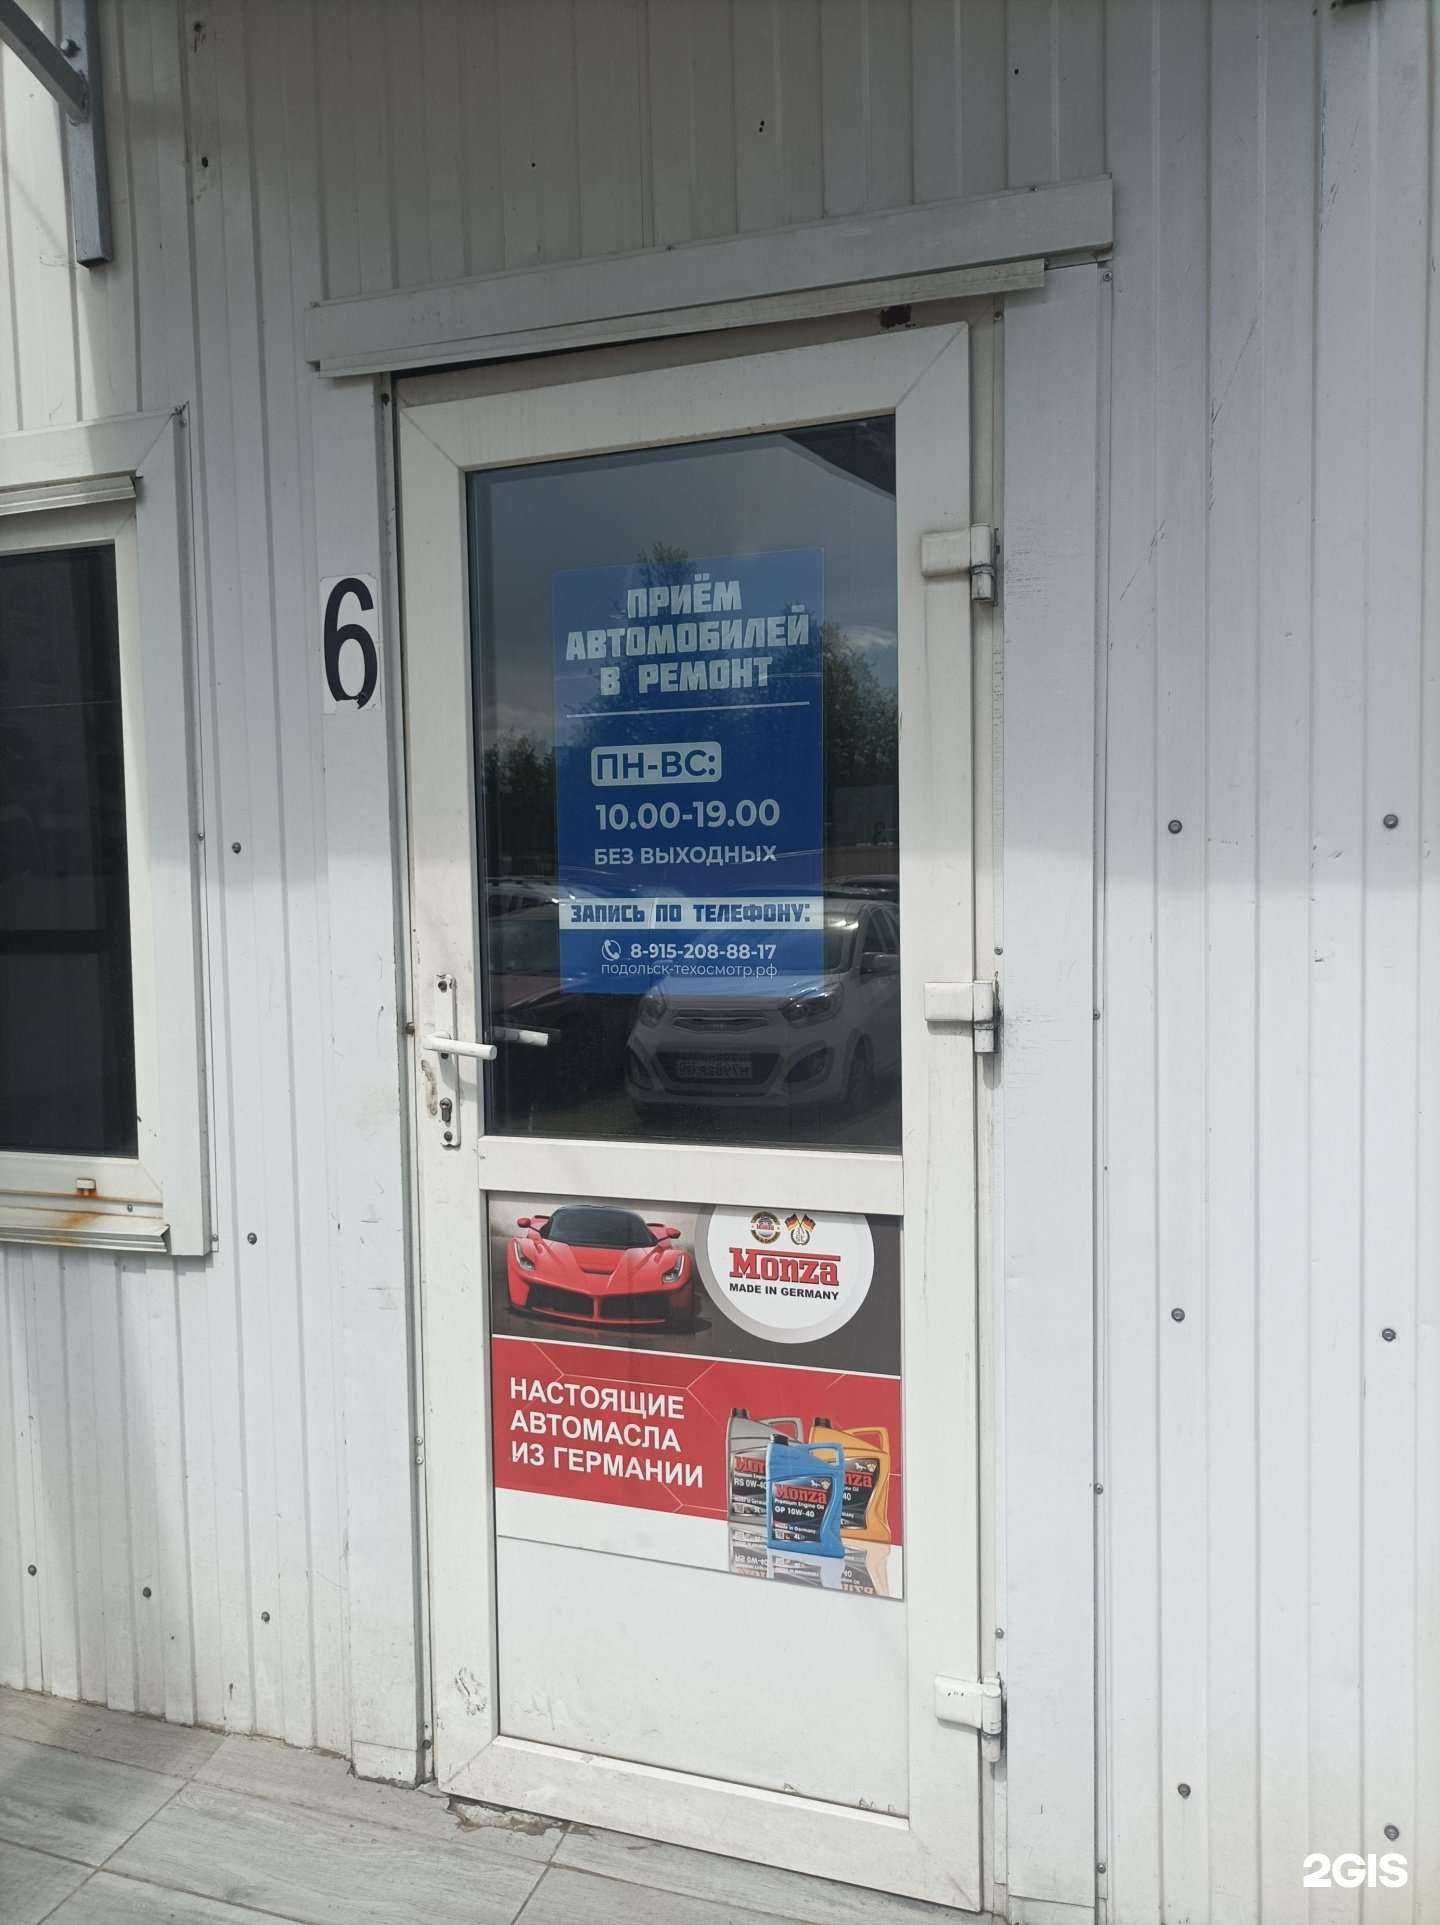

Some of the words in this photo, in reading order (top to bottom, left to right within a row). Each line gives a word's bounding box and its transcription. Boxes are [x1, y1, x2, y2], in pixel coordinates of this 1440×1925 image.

[627, 573, 742, 618] ПРИЁМ
[324, 577, 378, 710] 6
[566, 605, 809, 661] АВТОМОБИЛЕЙ
[600, 666, 621, 696] В
[638, 656, 773, 693] РЕМОНТ
[596, 748, 716, 780] ПН-ВС:
[595, 799, 780, 830] 10.00-19.00
[594, 848, 634, 865] БЕЗ
[640, 845, 777, 866] ВЫХОДНЫХ
[571, 904, 645, 923] ЗАПИСЬ
[655, 904, 682, 922] ПО
[693, 903, 811, 923] ТЕЛЕФОНУ:
[601, 963, 778, 980] подольск-техосмотр.рф
[630, 944, 777, 960] 8-915-208-88-17
[728, 1247, 841, 1286] Monza
[729, 1283, 762, 1295] MADE
[764, 1286, 777, 1296] IN
[780, 1287, 839, 1301] GERMANY
[510, 1376, 685, 1420] НАСТОЯЩИЕ
[510, 1410, 682, 1453] АВТОМАСЛА
[511, 1441, 545, 1467] ИЗ
[553, 1446, 704, 1489] ГЕРМАНИИ
